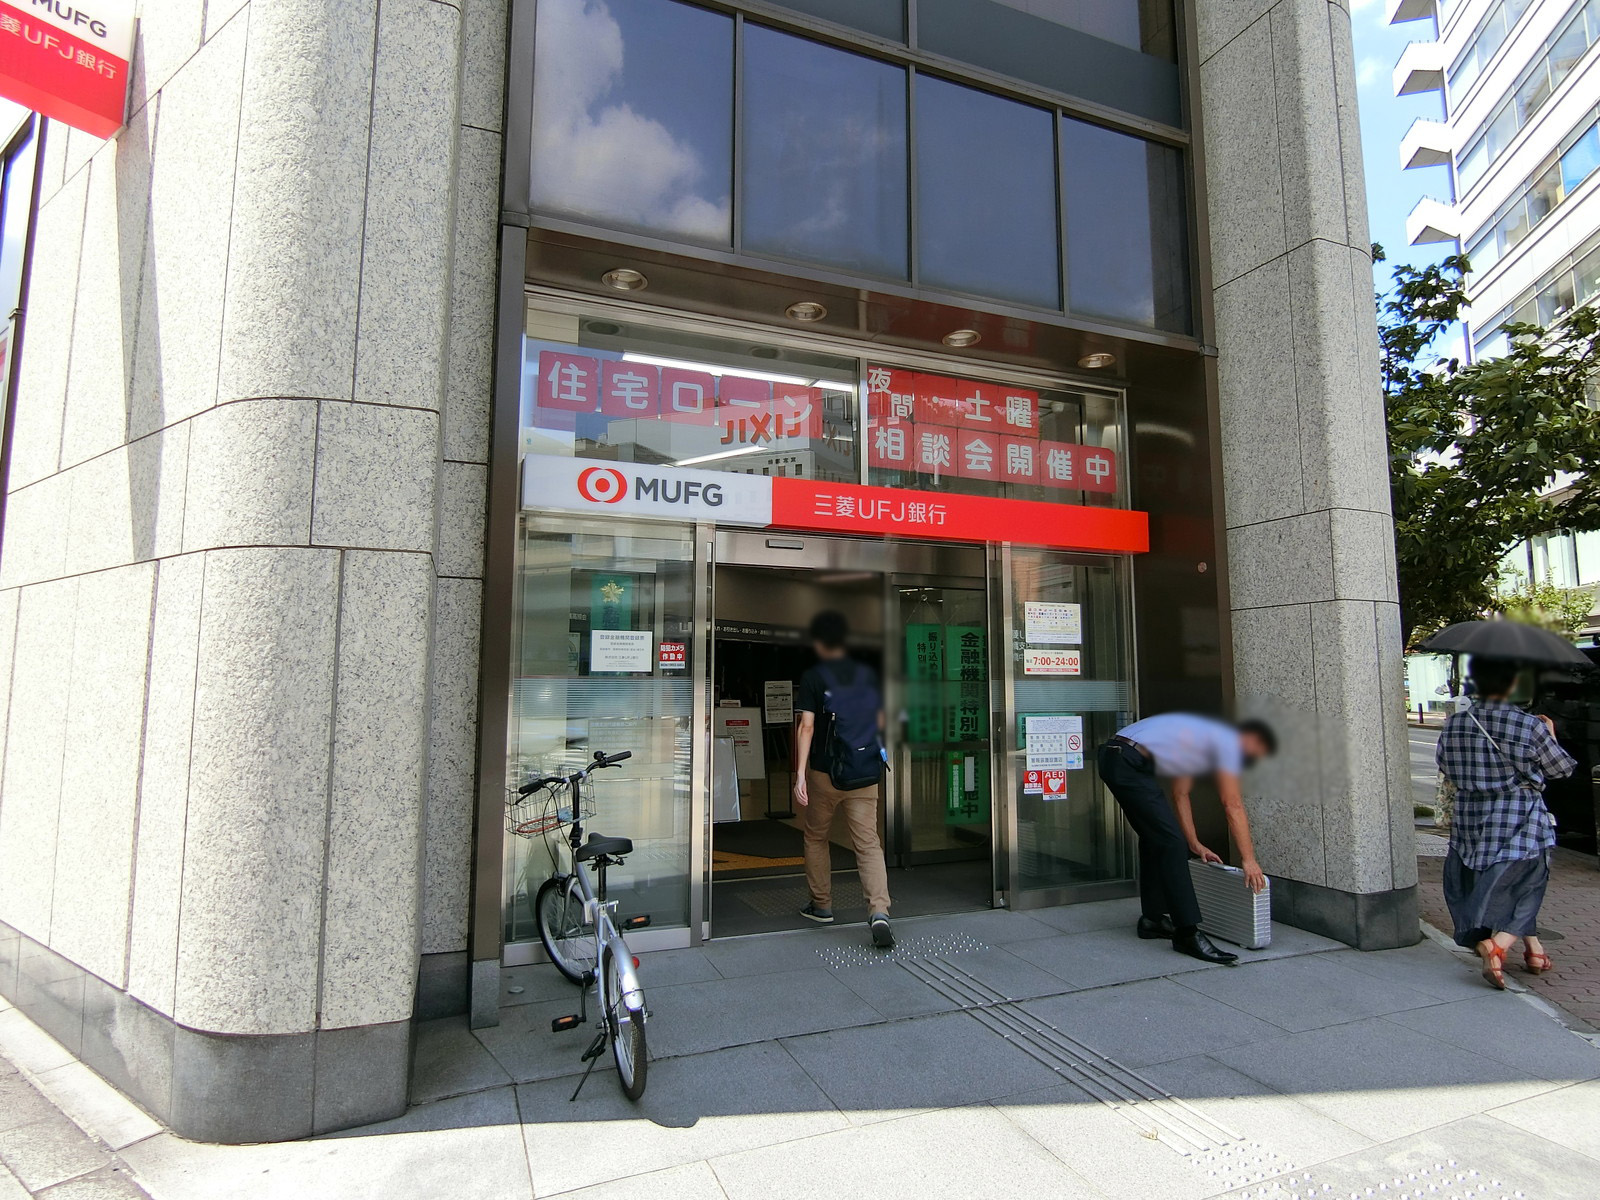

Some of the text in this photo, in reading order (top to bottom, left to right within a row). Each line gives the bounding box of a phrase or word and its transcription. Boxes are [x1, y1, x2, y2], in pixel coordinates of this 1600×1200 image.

[32, 0, 107, 38] MUFG
[548, 361, 813, 424] 住宅ローン
[875, 426, 1110, 484] 相談会開催中
[635, 476, 723, 506] MUFG
[814, 494, 946, 525] 三菱UFJ銀行
[960, 631, 980, 818] 金融機関特別中
